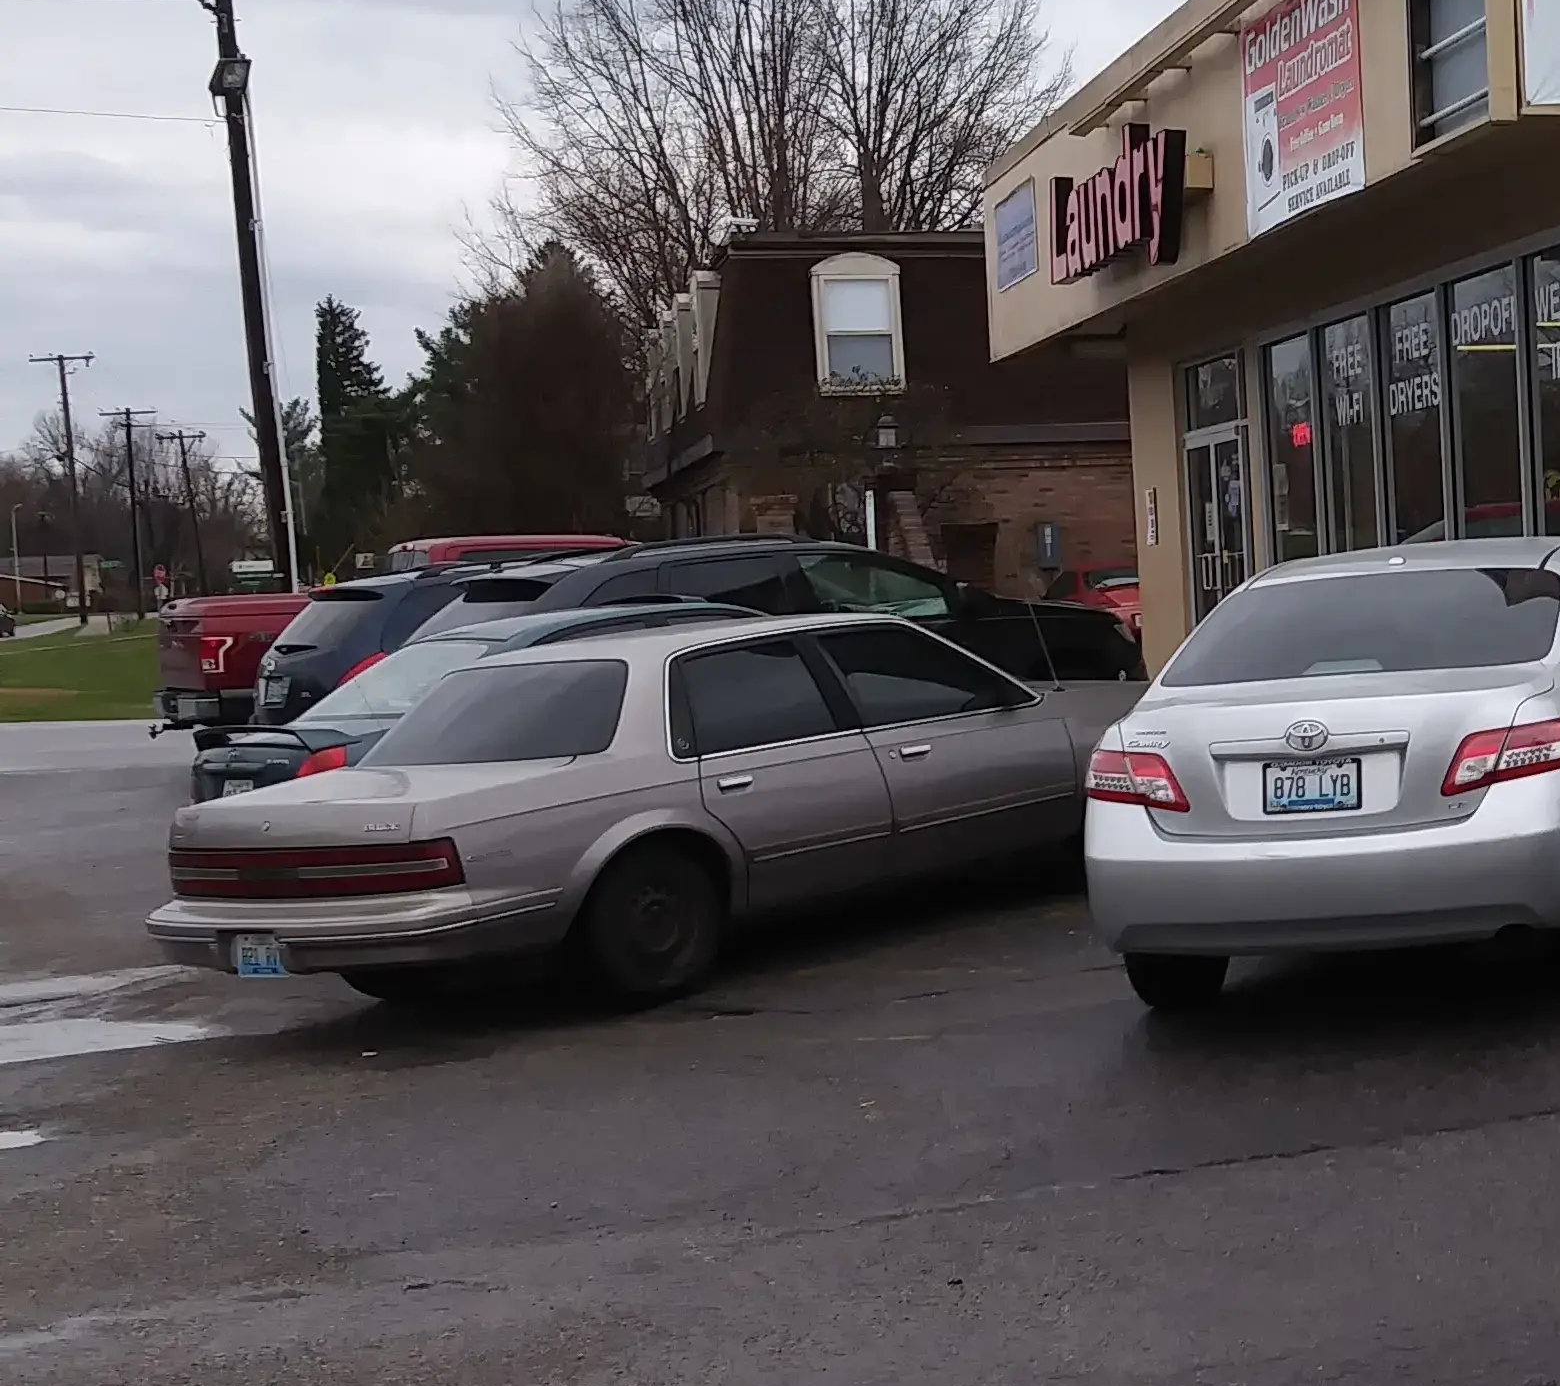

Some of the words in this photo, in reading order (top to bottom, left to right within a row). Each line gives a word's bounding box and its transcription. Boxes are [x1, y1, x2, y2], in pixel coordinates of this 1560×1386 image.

[1277, 17, 1352, 101] Laundromat
[1282, 162, 1310, 191] PICK-UP
[1287, 186, 1314, 213] SERVICE
[1315, 168, 1351, 200] AVAILABLE
[1050, 123, 1168, 285] Laundry
[1534, 282, 1560, 322] WE
[1333, 342, 1361, 380] FREE
[1395, 322, 1430, 364] FREE
[1335, 391, 1364, 426] WI-FI
[1389, 372, 1440, 416] DRYERS
[1274, 775, 1306, 799] 878
[1319, 773, 1351, 797] LYB
